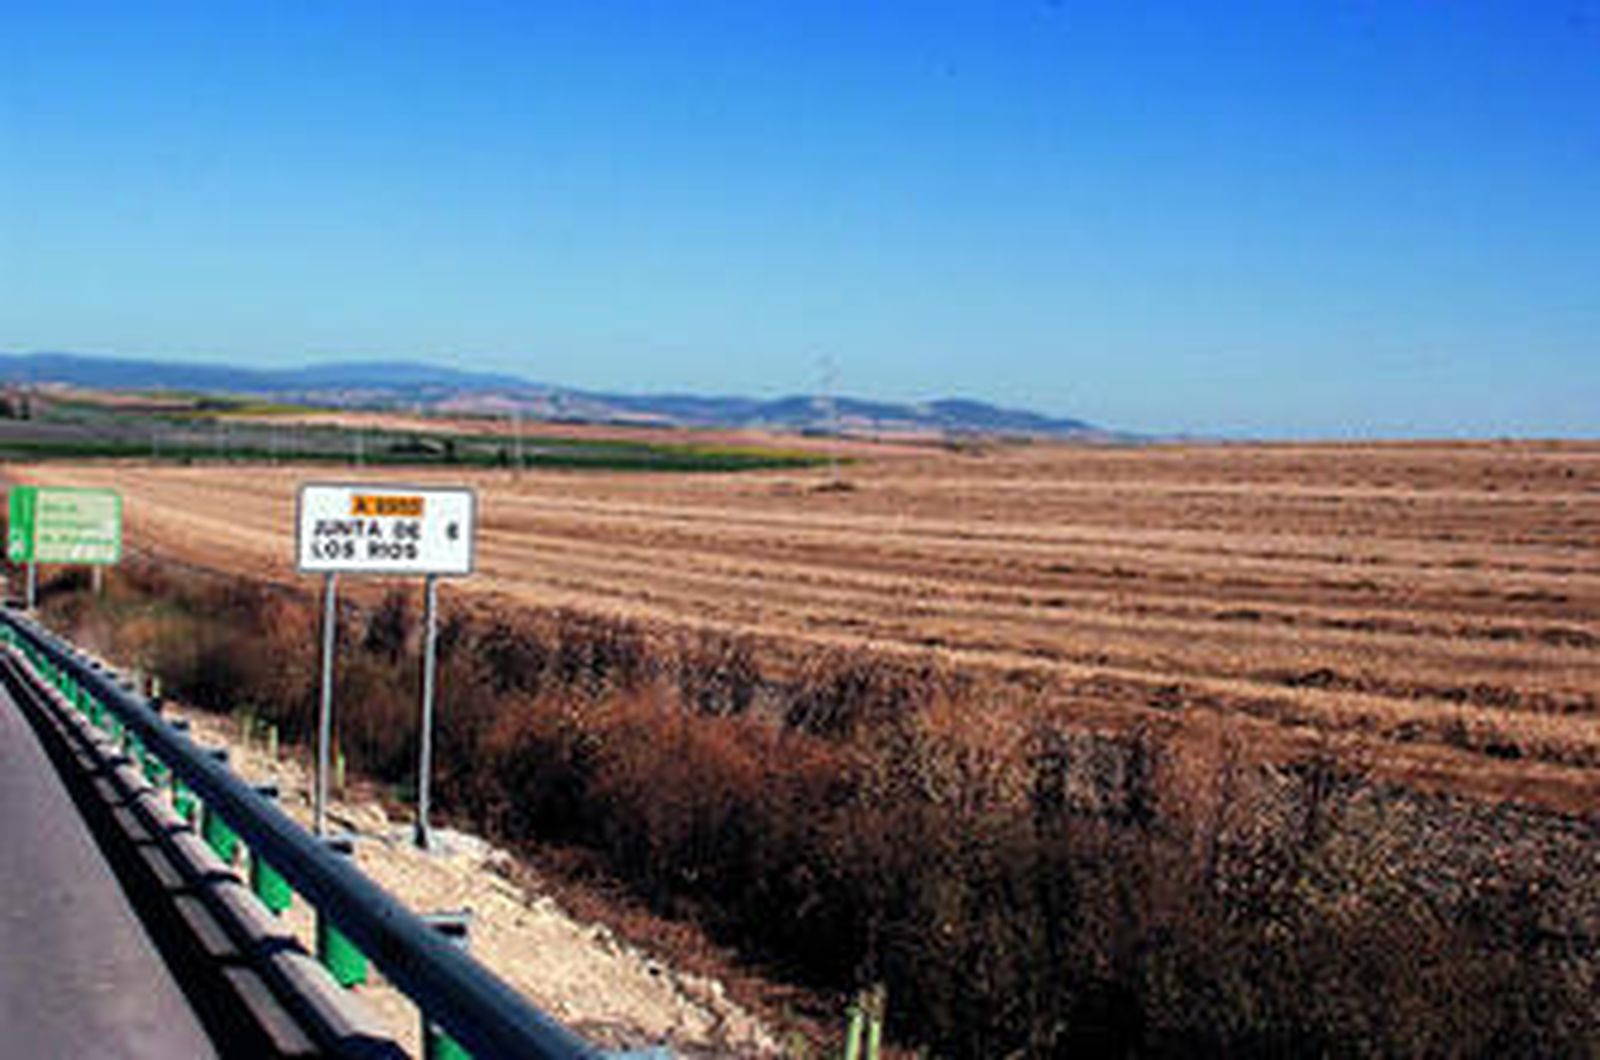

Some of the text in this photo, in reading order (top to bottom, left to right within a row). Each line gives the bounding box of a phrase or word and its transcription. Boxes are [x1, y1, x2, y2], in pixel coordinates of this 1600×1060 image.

[313, 519, 421, 541] JUNTA DE
[311, 539, 418, 560] LOS RIOS
